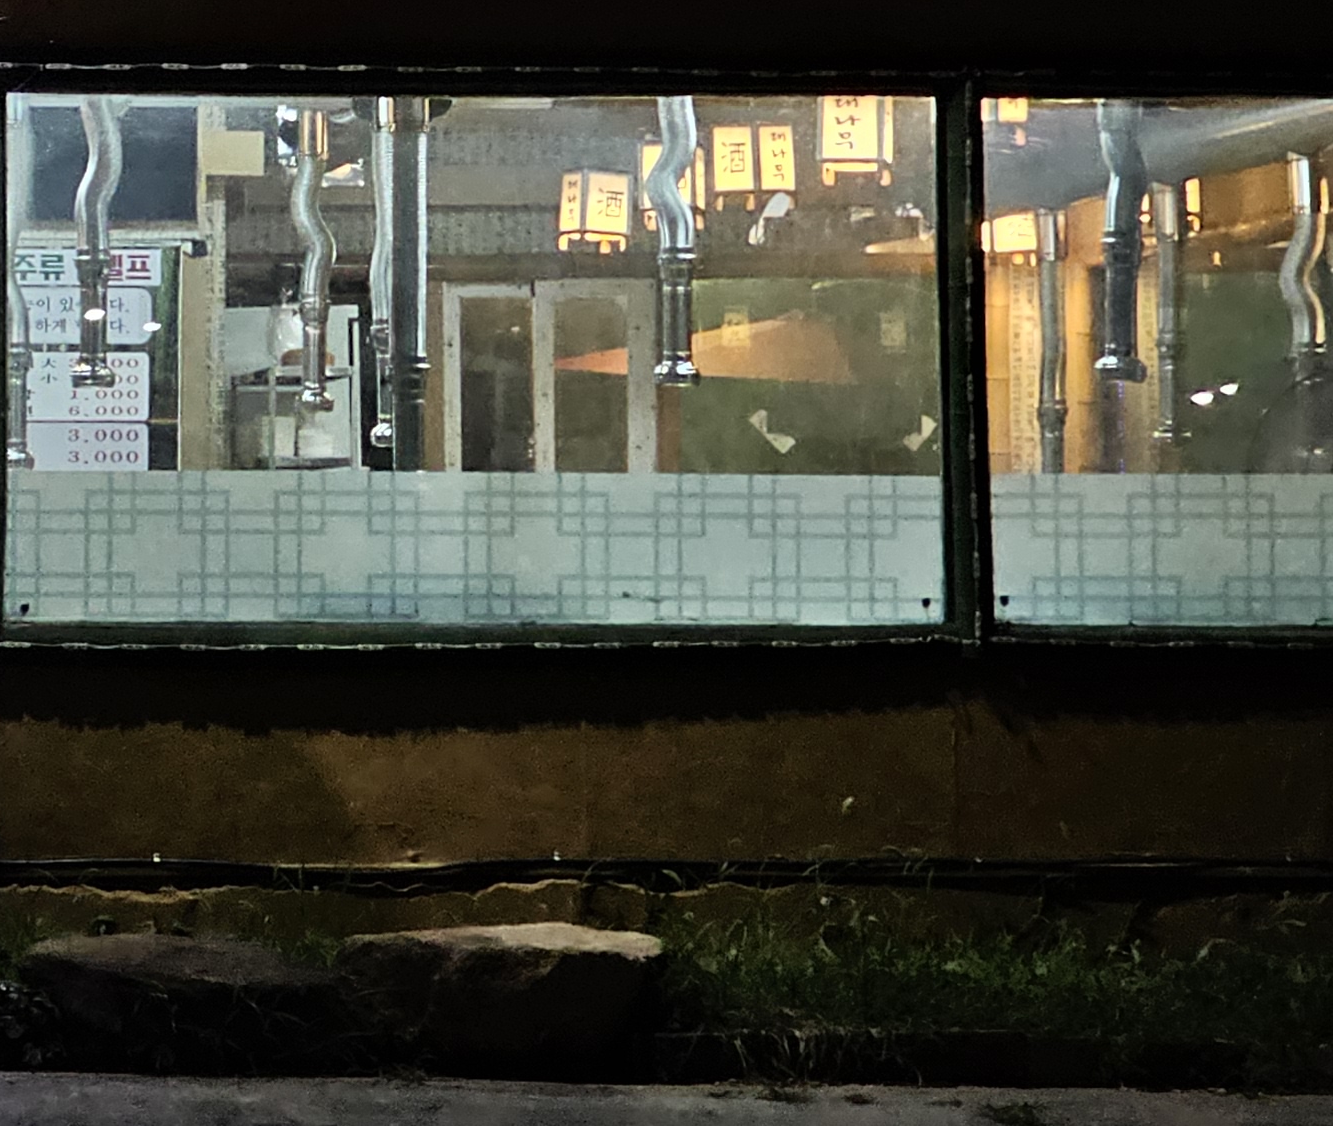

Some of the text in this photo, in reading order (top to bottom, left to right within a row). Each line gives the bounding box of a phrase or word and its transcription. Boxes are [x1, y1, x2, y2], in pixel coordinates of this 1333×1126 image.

[721, 142, 746, 173] 酒
[597, 188, 624, 217] 酒
[14, 254, 65, 281] 주류
[60, 296, 129, 313] 있다.
